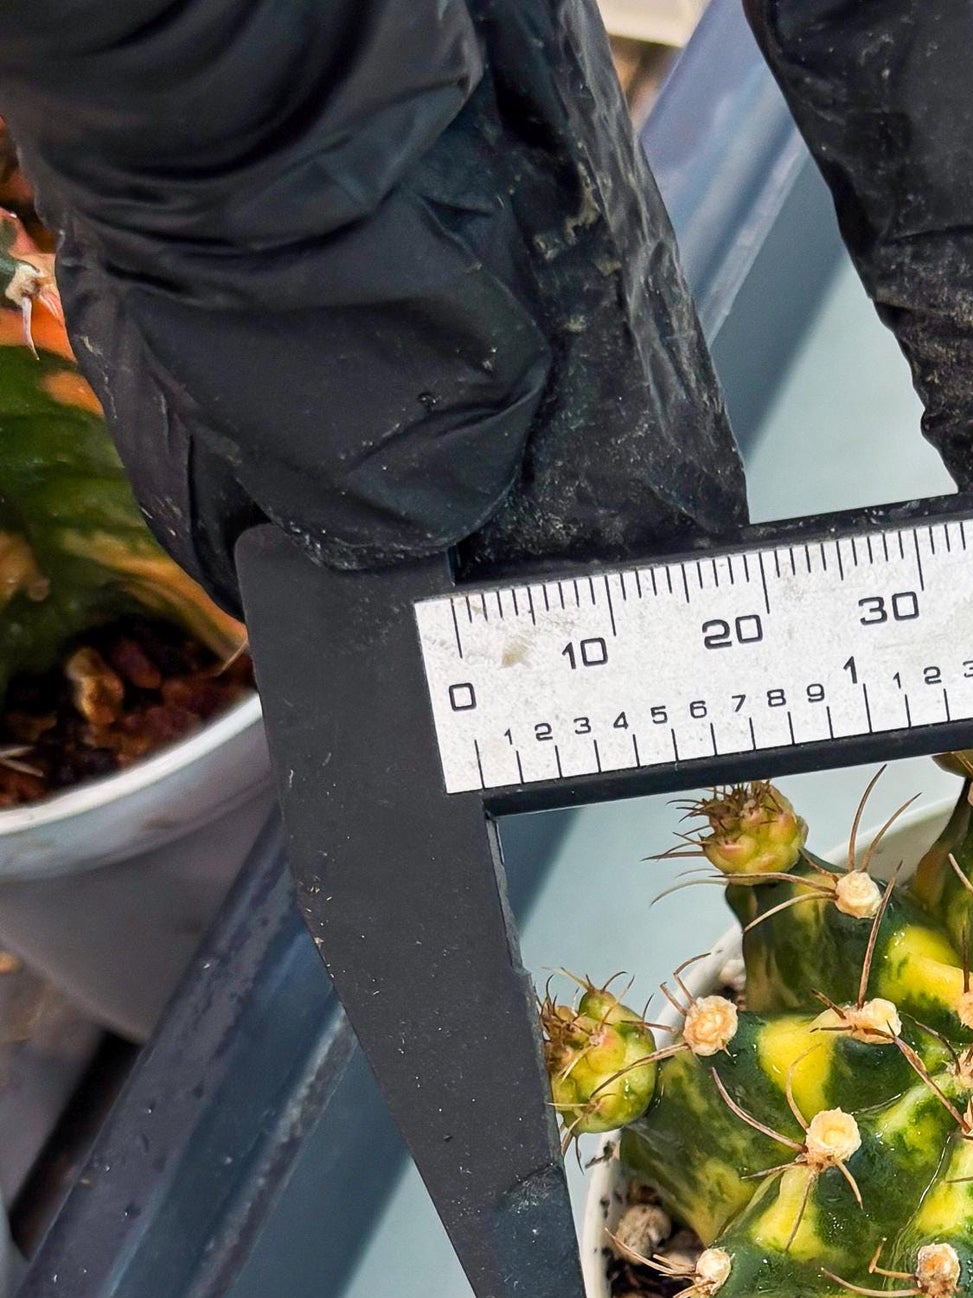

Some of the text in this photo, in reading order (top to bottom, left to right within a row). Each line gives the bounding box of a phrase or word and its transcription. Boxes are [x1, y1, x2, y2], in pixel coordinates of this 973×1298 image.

[448, 682, 477, 712] 0
[561, 637, 608, 670] 10
[701, 614, 763, 650] 20
[858, 591, 920, 626] 30
[503, 728, 514, 746] 1
[534, 722, 553, 742] 2
[573, 716, 592, 735] 3
[612, 711, 629, 730] 4
[650, 705, 668, 724] 5
[689, 700, 708, 719] 6
[730, 694, 747, 713] 7
[766, 688, 787, 708] 8
[806, 683, 825, 703] 9
[842, 655, 858, 684] 1
[891, 671, 903, 689] 1
[922, 666, 942, 685] 2
